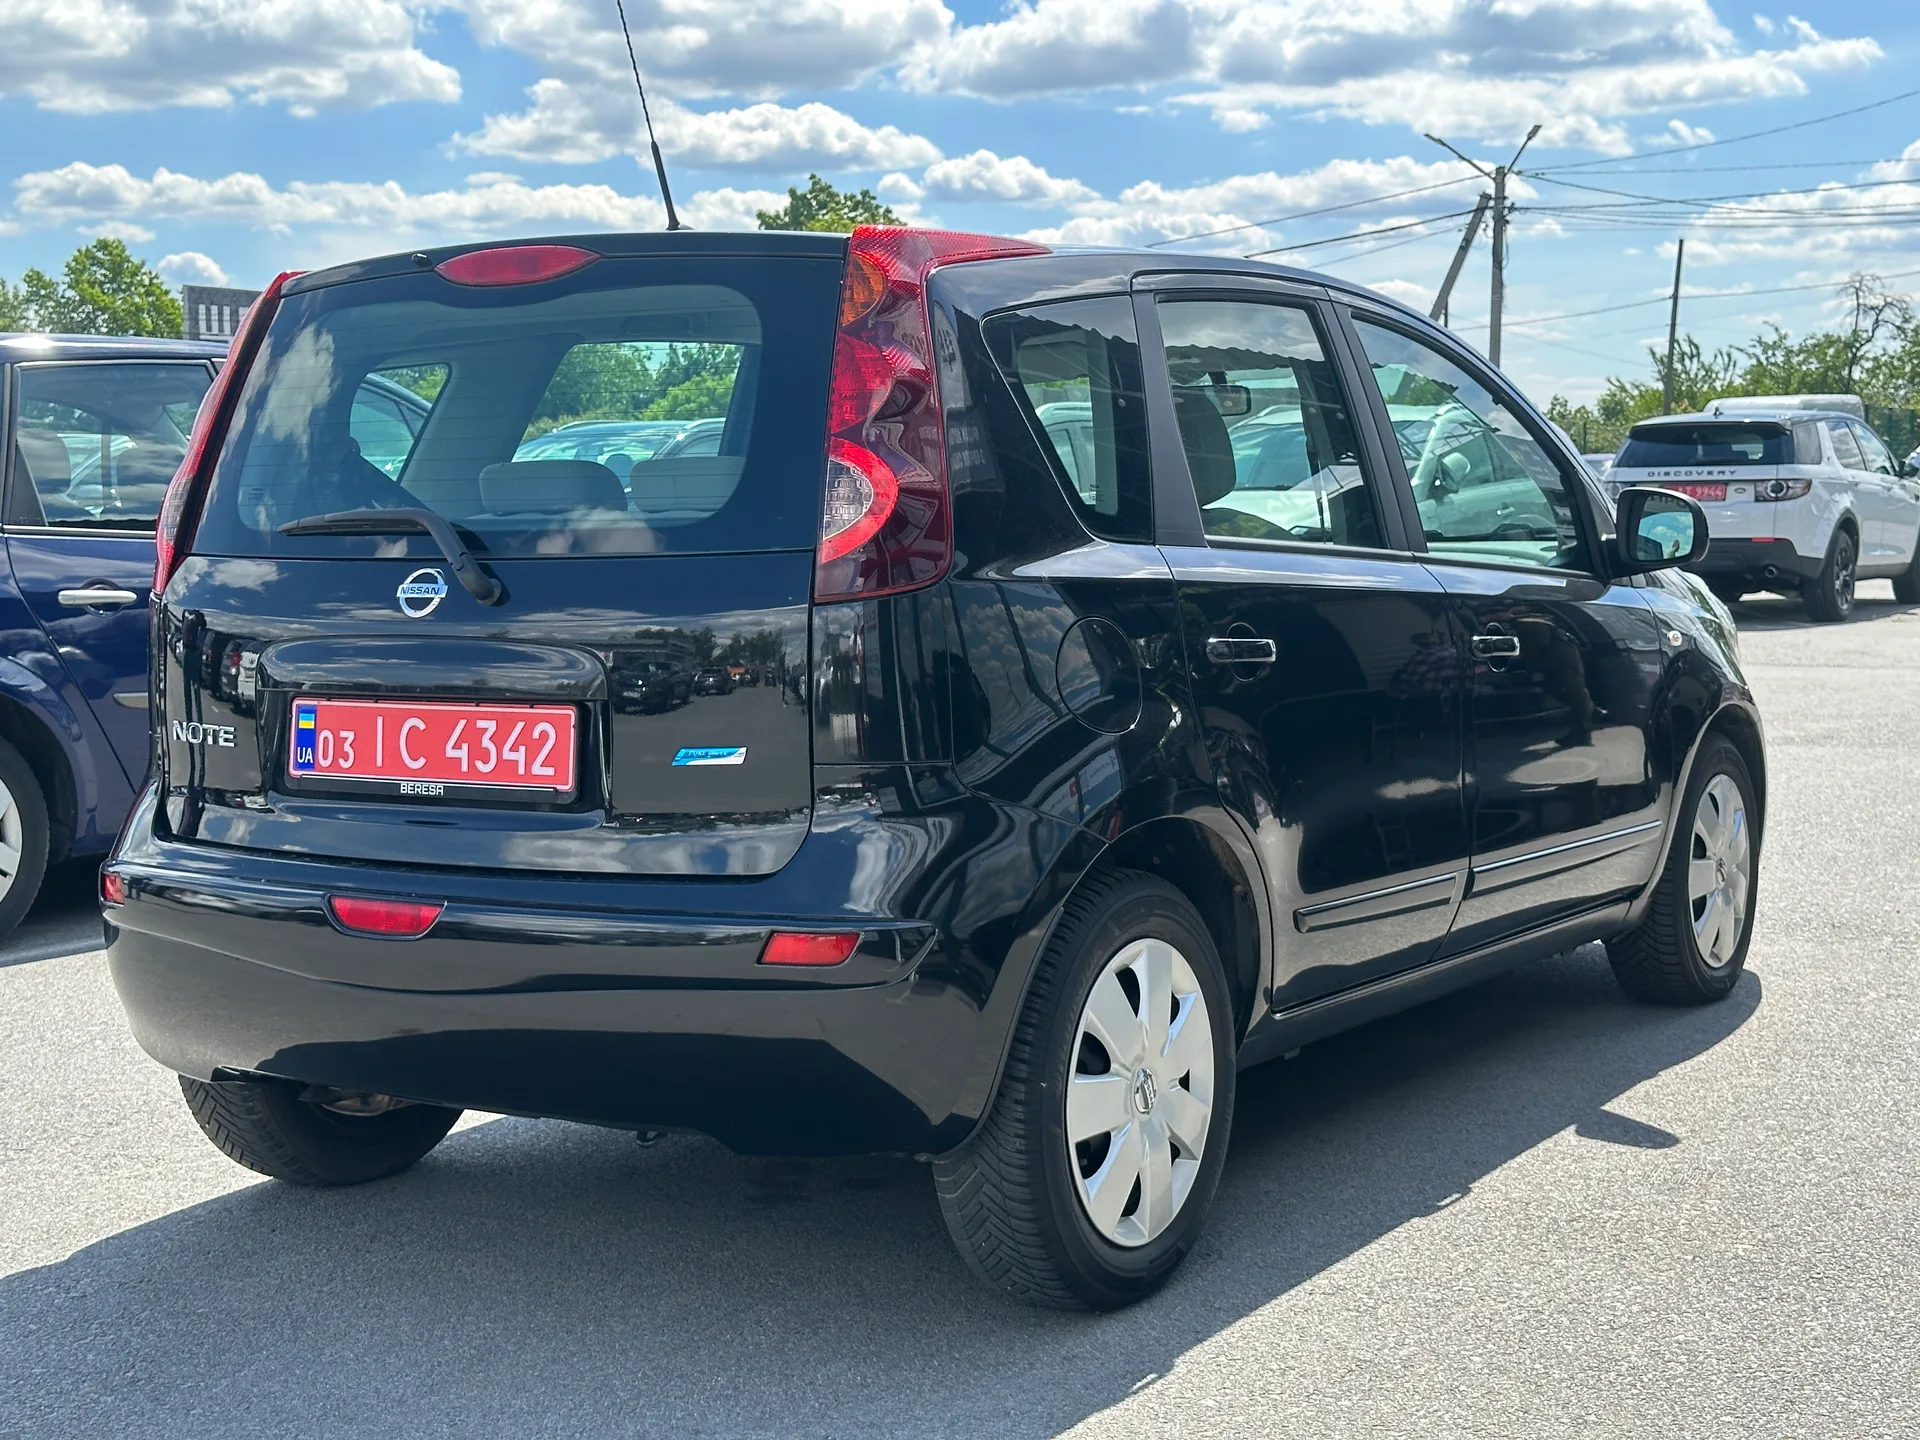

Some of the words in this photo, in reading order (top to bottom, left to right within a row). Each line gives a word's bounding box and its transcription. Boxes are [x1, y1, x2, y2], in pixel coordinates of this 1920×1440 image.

[400, 586, 440, 595] NISSAN
[173, 720, 235, 747] NOTE
[297, 747, 314, 763] UA
[318, 729, 355, 769] 03
[445, 719, 557, 776] 4342
[400, 783, 444, 796] BERESA
